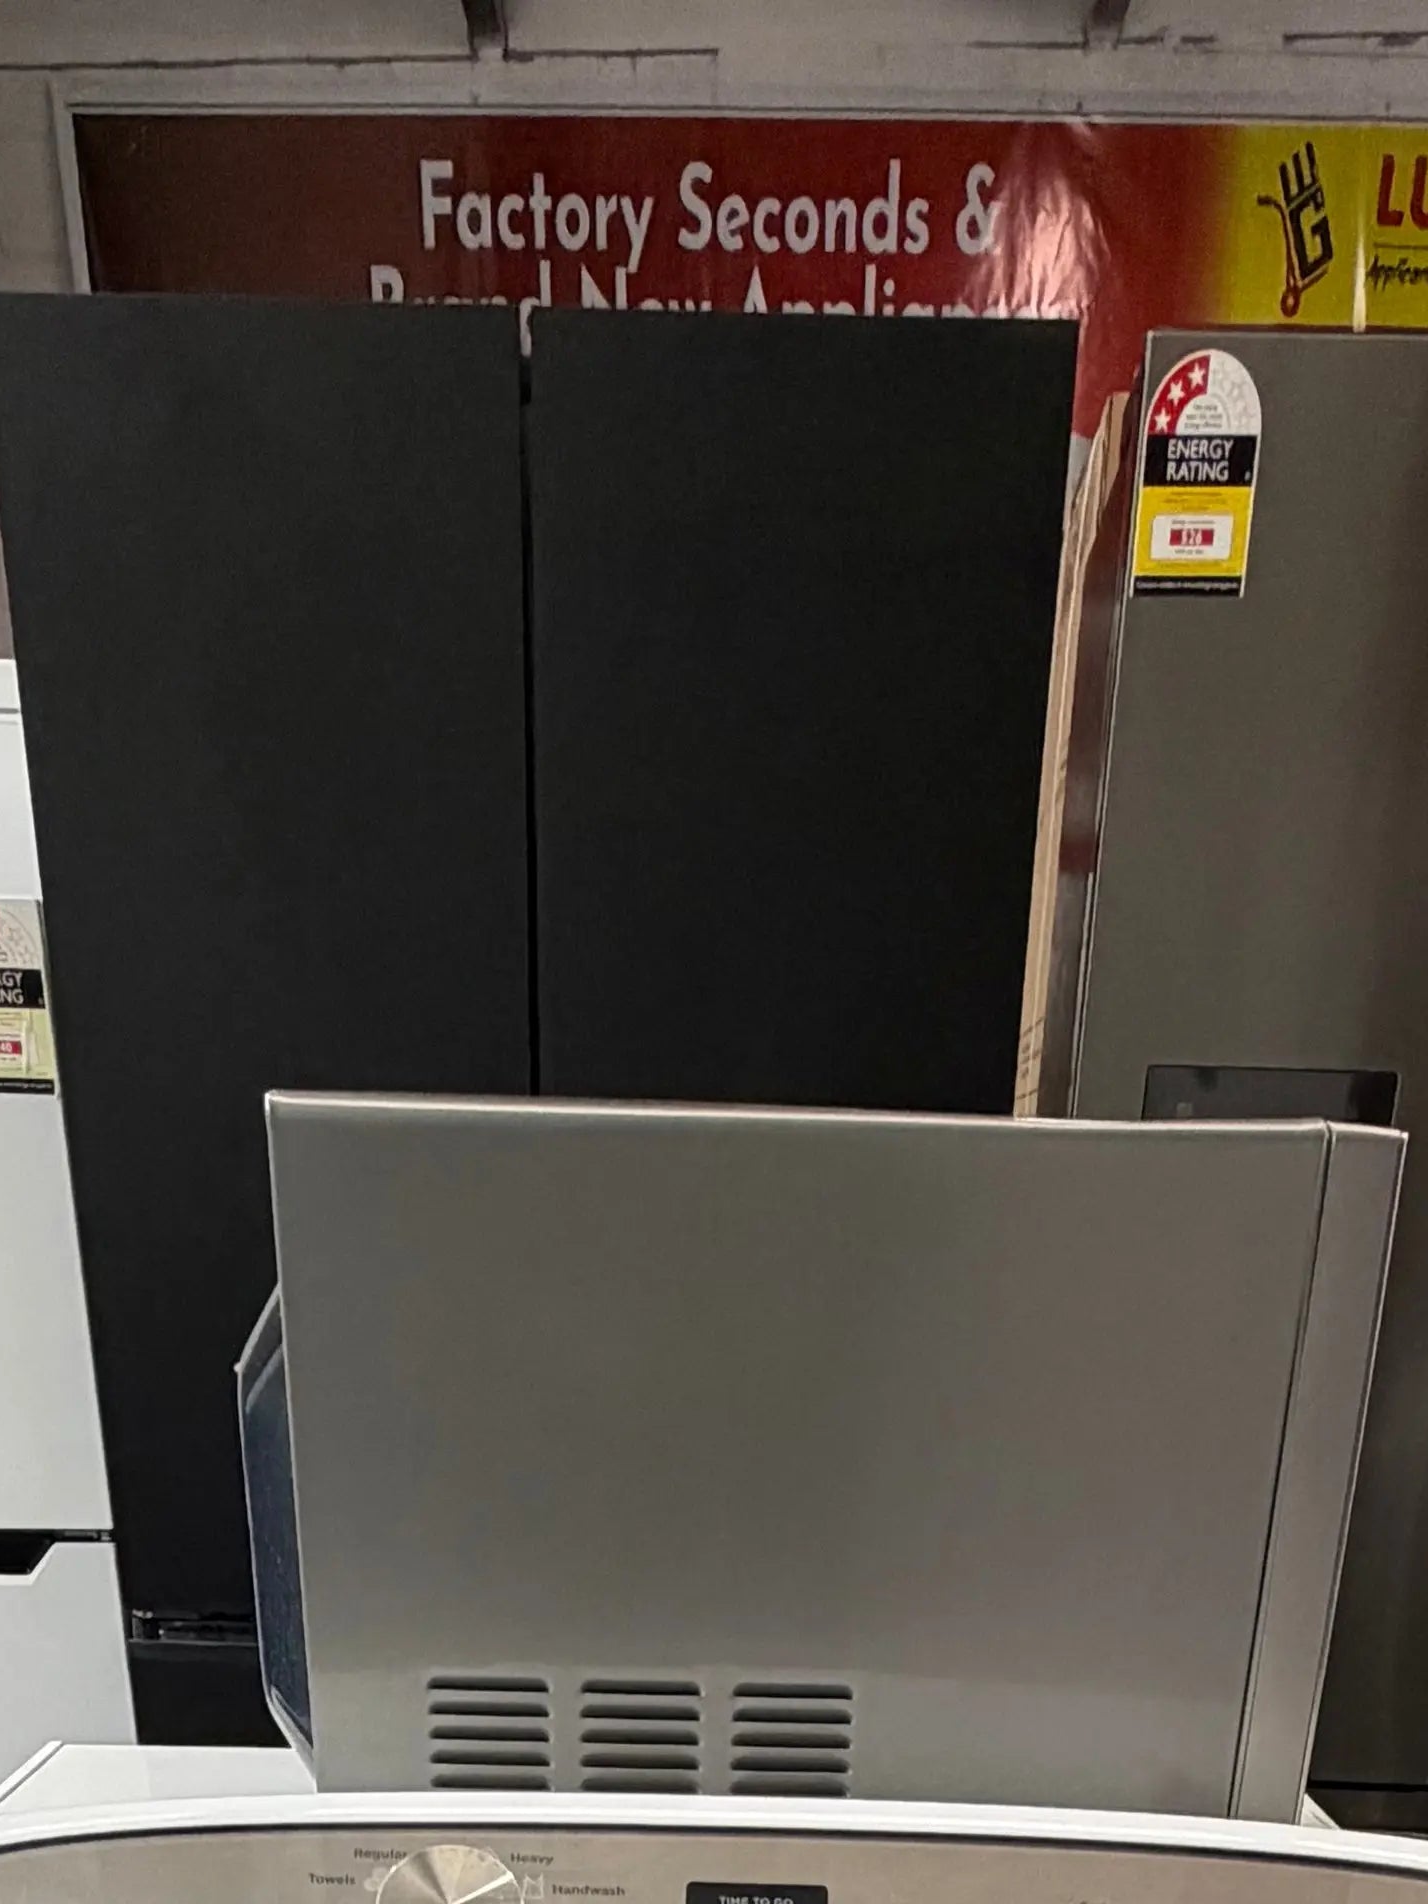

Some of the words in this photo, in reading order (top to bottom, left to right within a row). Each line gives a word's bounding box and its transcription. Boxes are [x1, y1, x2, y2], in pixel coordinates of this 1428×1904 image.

[419, 158, 653, 273] Factory
[678, 159, 930, 254] Seconds
[955, 161, 998, 255] &
[1166, 439, 1234, 460] ENERGY
[1166, 460, 1230, 482] RATING
[353, 1847, 408, 1861] Regular
[510, 1852, 554, 1866] Heavy
[308, 1872, 356, 1886] Towels
[551, 1883, 626, 1897] Handwash
